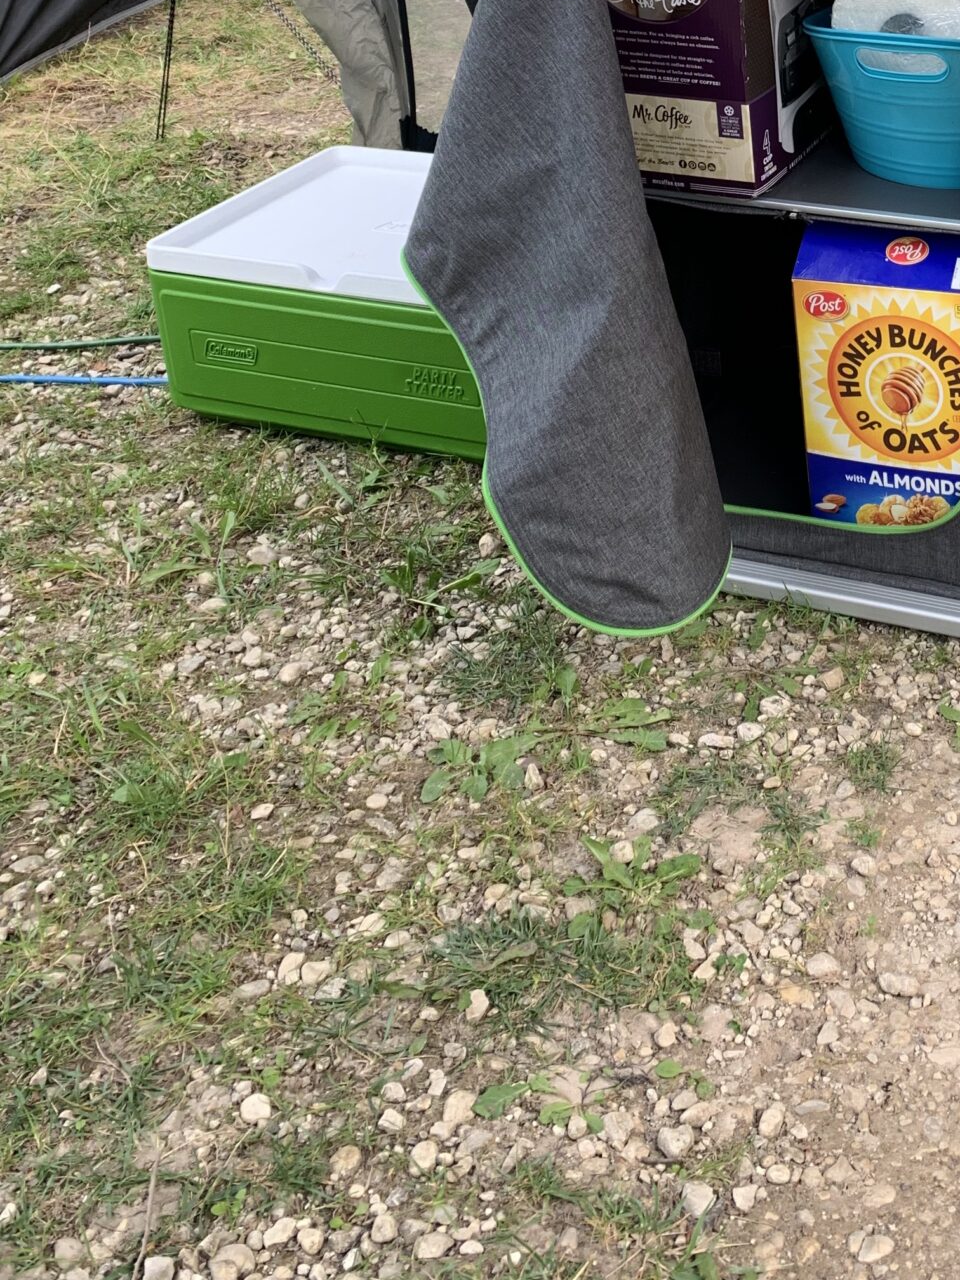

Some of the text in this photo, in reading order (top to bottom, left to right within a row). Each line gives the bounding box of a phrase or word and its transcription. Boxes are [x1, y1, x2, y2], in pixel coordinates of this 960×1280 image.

[632, 104, 692, 130] Mr. Coffee
[763, 128, 771, 154] 4
[890, 242, 922, 260] Post
[808, 294, 842, 314] Post
[209, 342, 246, 358] Coleman
[836, 324, 882, 398] HONEY
[412, 367, 457, 386] PARTY
[403, 378, 464, 400] STACKER
[882, 420, 960, 454] OATS
[845, 472, 866, 484] with
